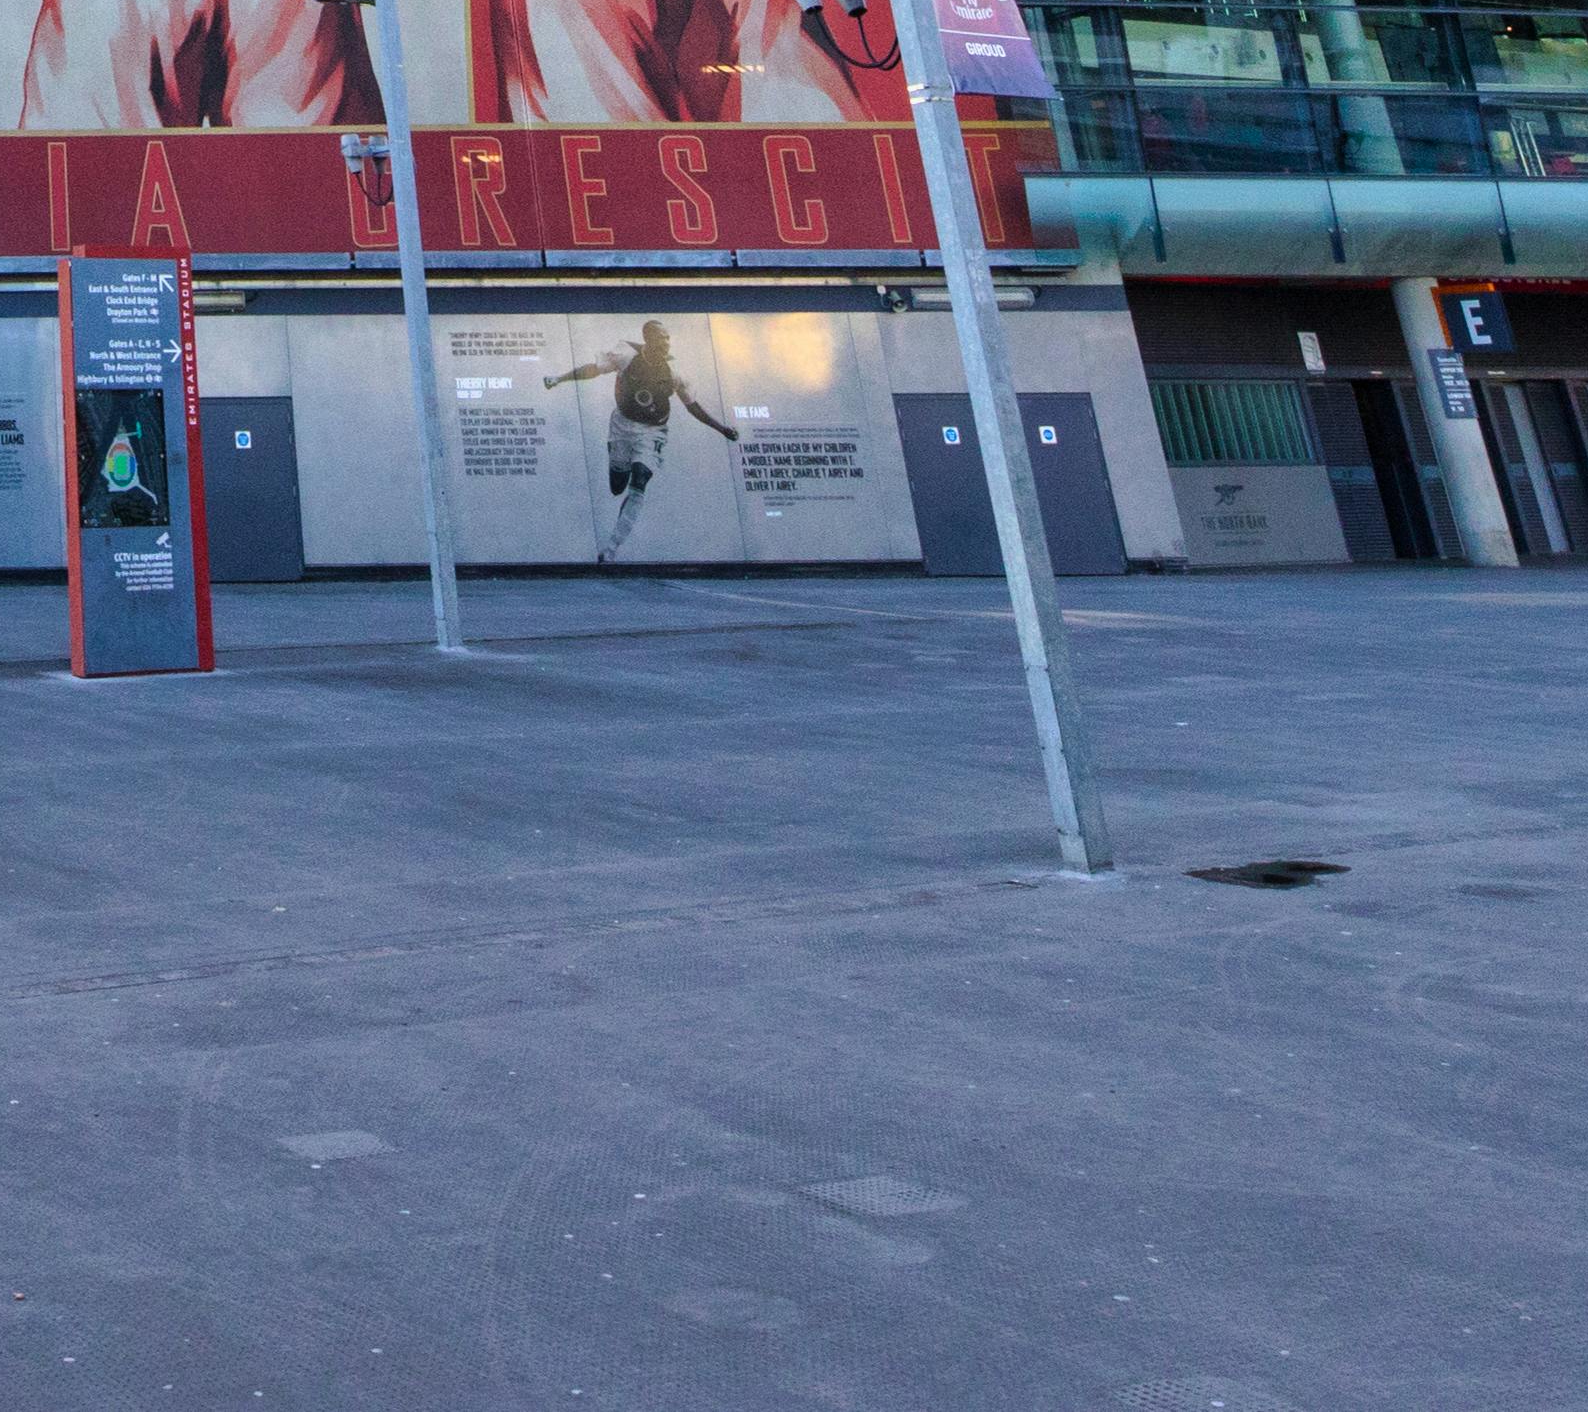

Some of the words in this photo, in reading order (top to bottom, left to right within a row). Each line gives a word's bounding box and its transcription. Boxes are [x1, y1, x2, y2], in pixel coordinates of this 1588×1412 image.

[965, 42, 1006, 57] GIROUD
[88, 284, 102, 293] East
[110, 284, 129, 293] South
[130, 284, 158, 293] Entrance
[180, 258, 191, 330] STADIUM
[106, 296, 123, 305] Clock
[124, 296, 136, 305] End
[137, 296, 158, 306] Bridge
[133, 308, 148, 316] Park
[1460, 299, 1492, 345] E
[103, 363, 115, 371] The
[185, 342, 197, 425] EMIRATES
[488, 377, 512, 389] HENRY
[733, 406, 748, 418] THE
[749, 406, 770, 419] FANS
[114, 552, 130, 562] CCTV
[140, 551, 172, 562] operation
